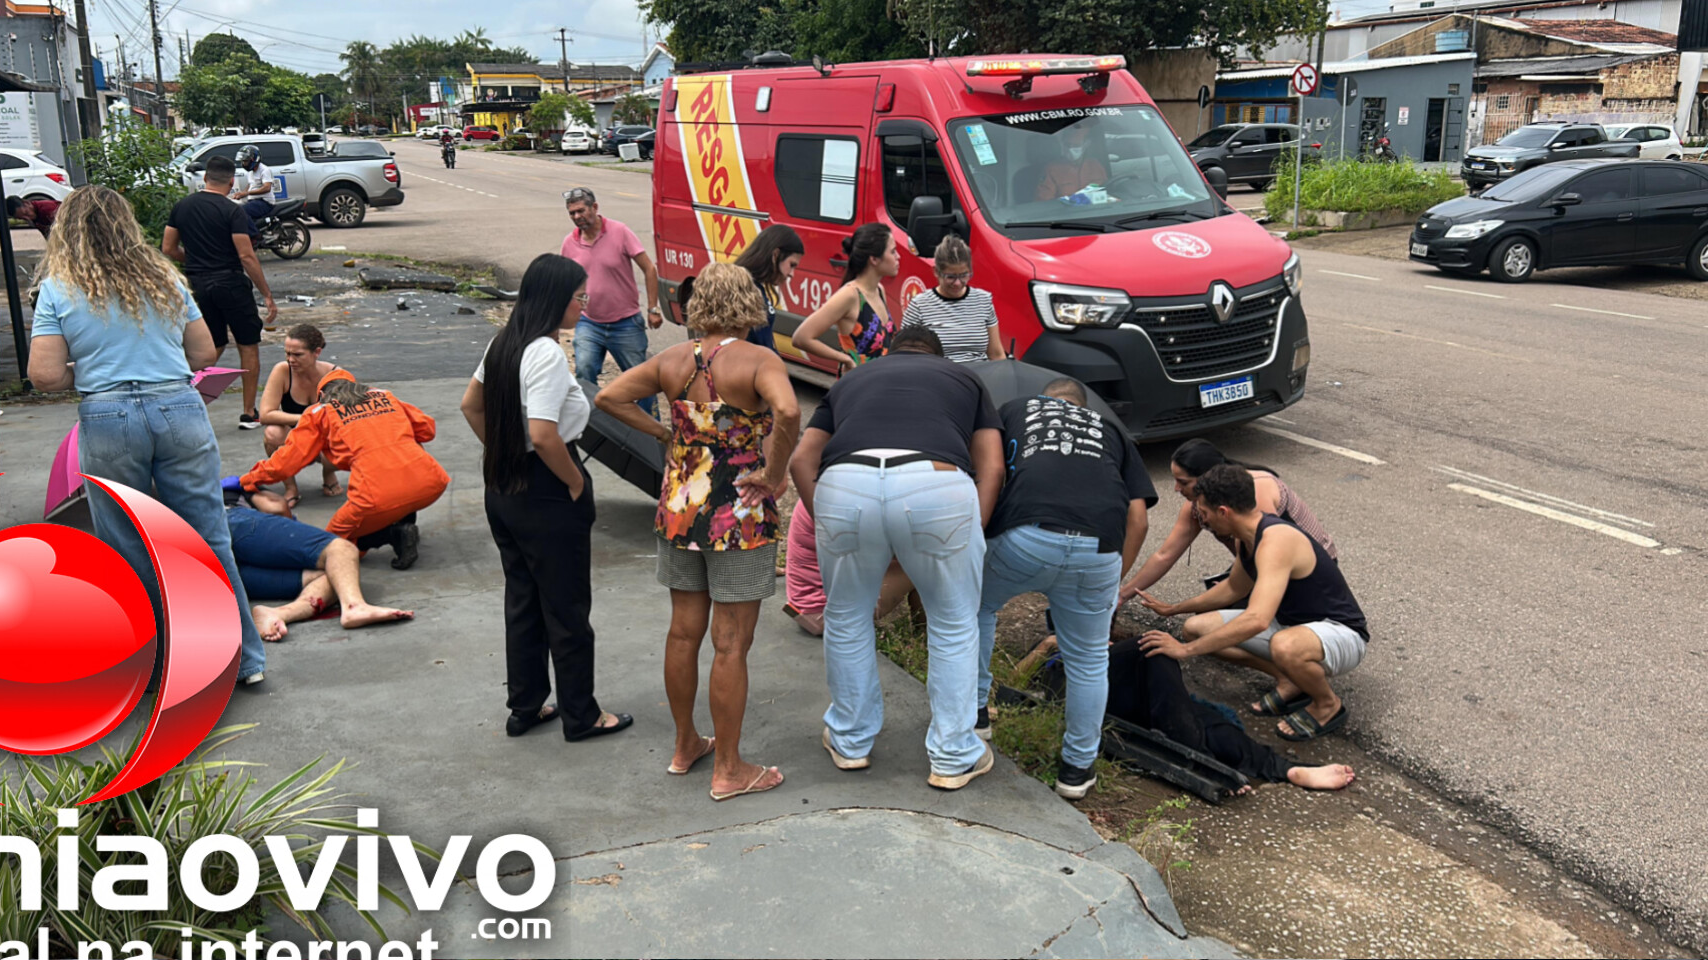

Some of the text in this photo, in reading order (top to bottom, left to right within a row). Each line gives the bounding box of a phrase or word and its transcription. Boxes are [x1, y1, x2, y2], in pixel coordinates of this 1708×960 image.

[1005, 107, 1123, 125] WWW.CBM.RO.GOV.BR
[691, 81, 746, 258] RESGAT
[665, 248, 694, 269] UR 130
[800, 278, 832, 310] 193
[336, 397, 393, 420] MILITAR
